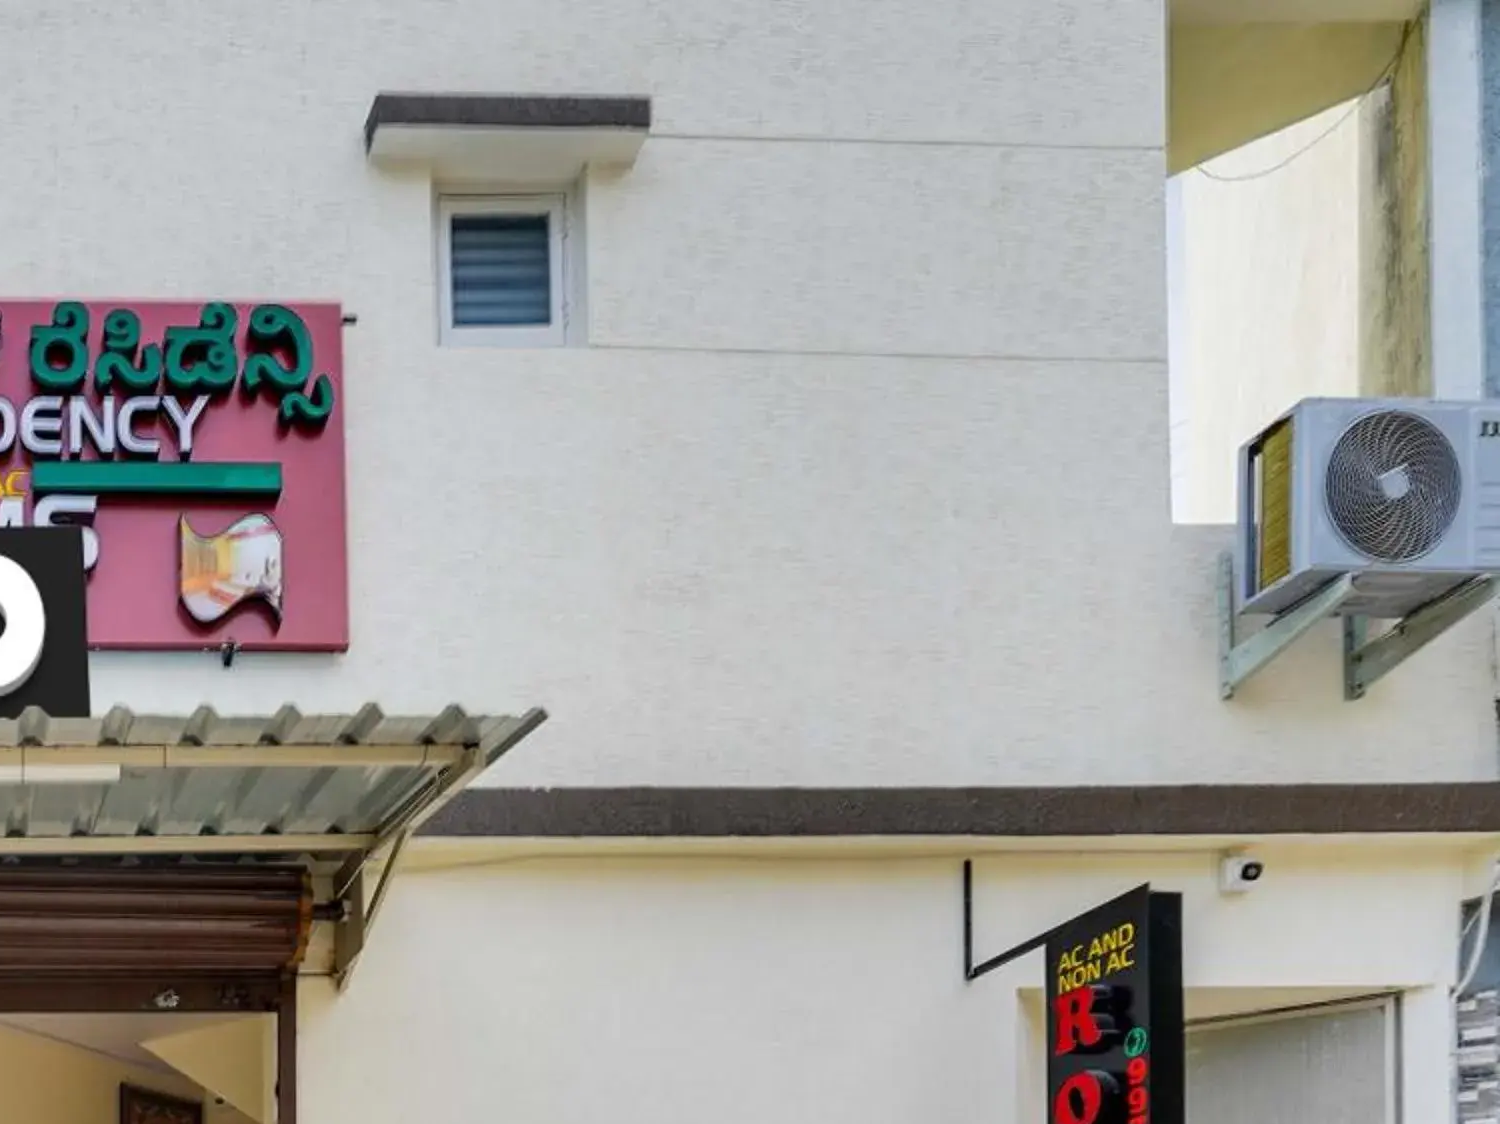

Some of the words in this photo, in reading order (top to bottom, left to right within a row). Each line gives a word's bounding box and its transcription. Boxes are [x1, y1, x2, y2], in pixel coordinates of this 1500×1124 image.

[1058, 945, 1085, 971] AC
[1087, 922, 1135, 960] AND
[1058, 958, 1101, 995] NON
[1105, 943, 1136, 977] AC
